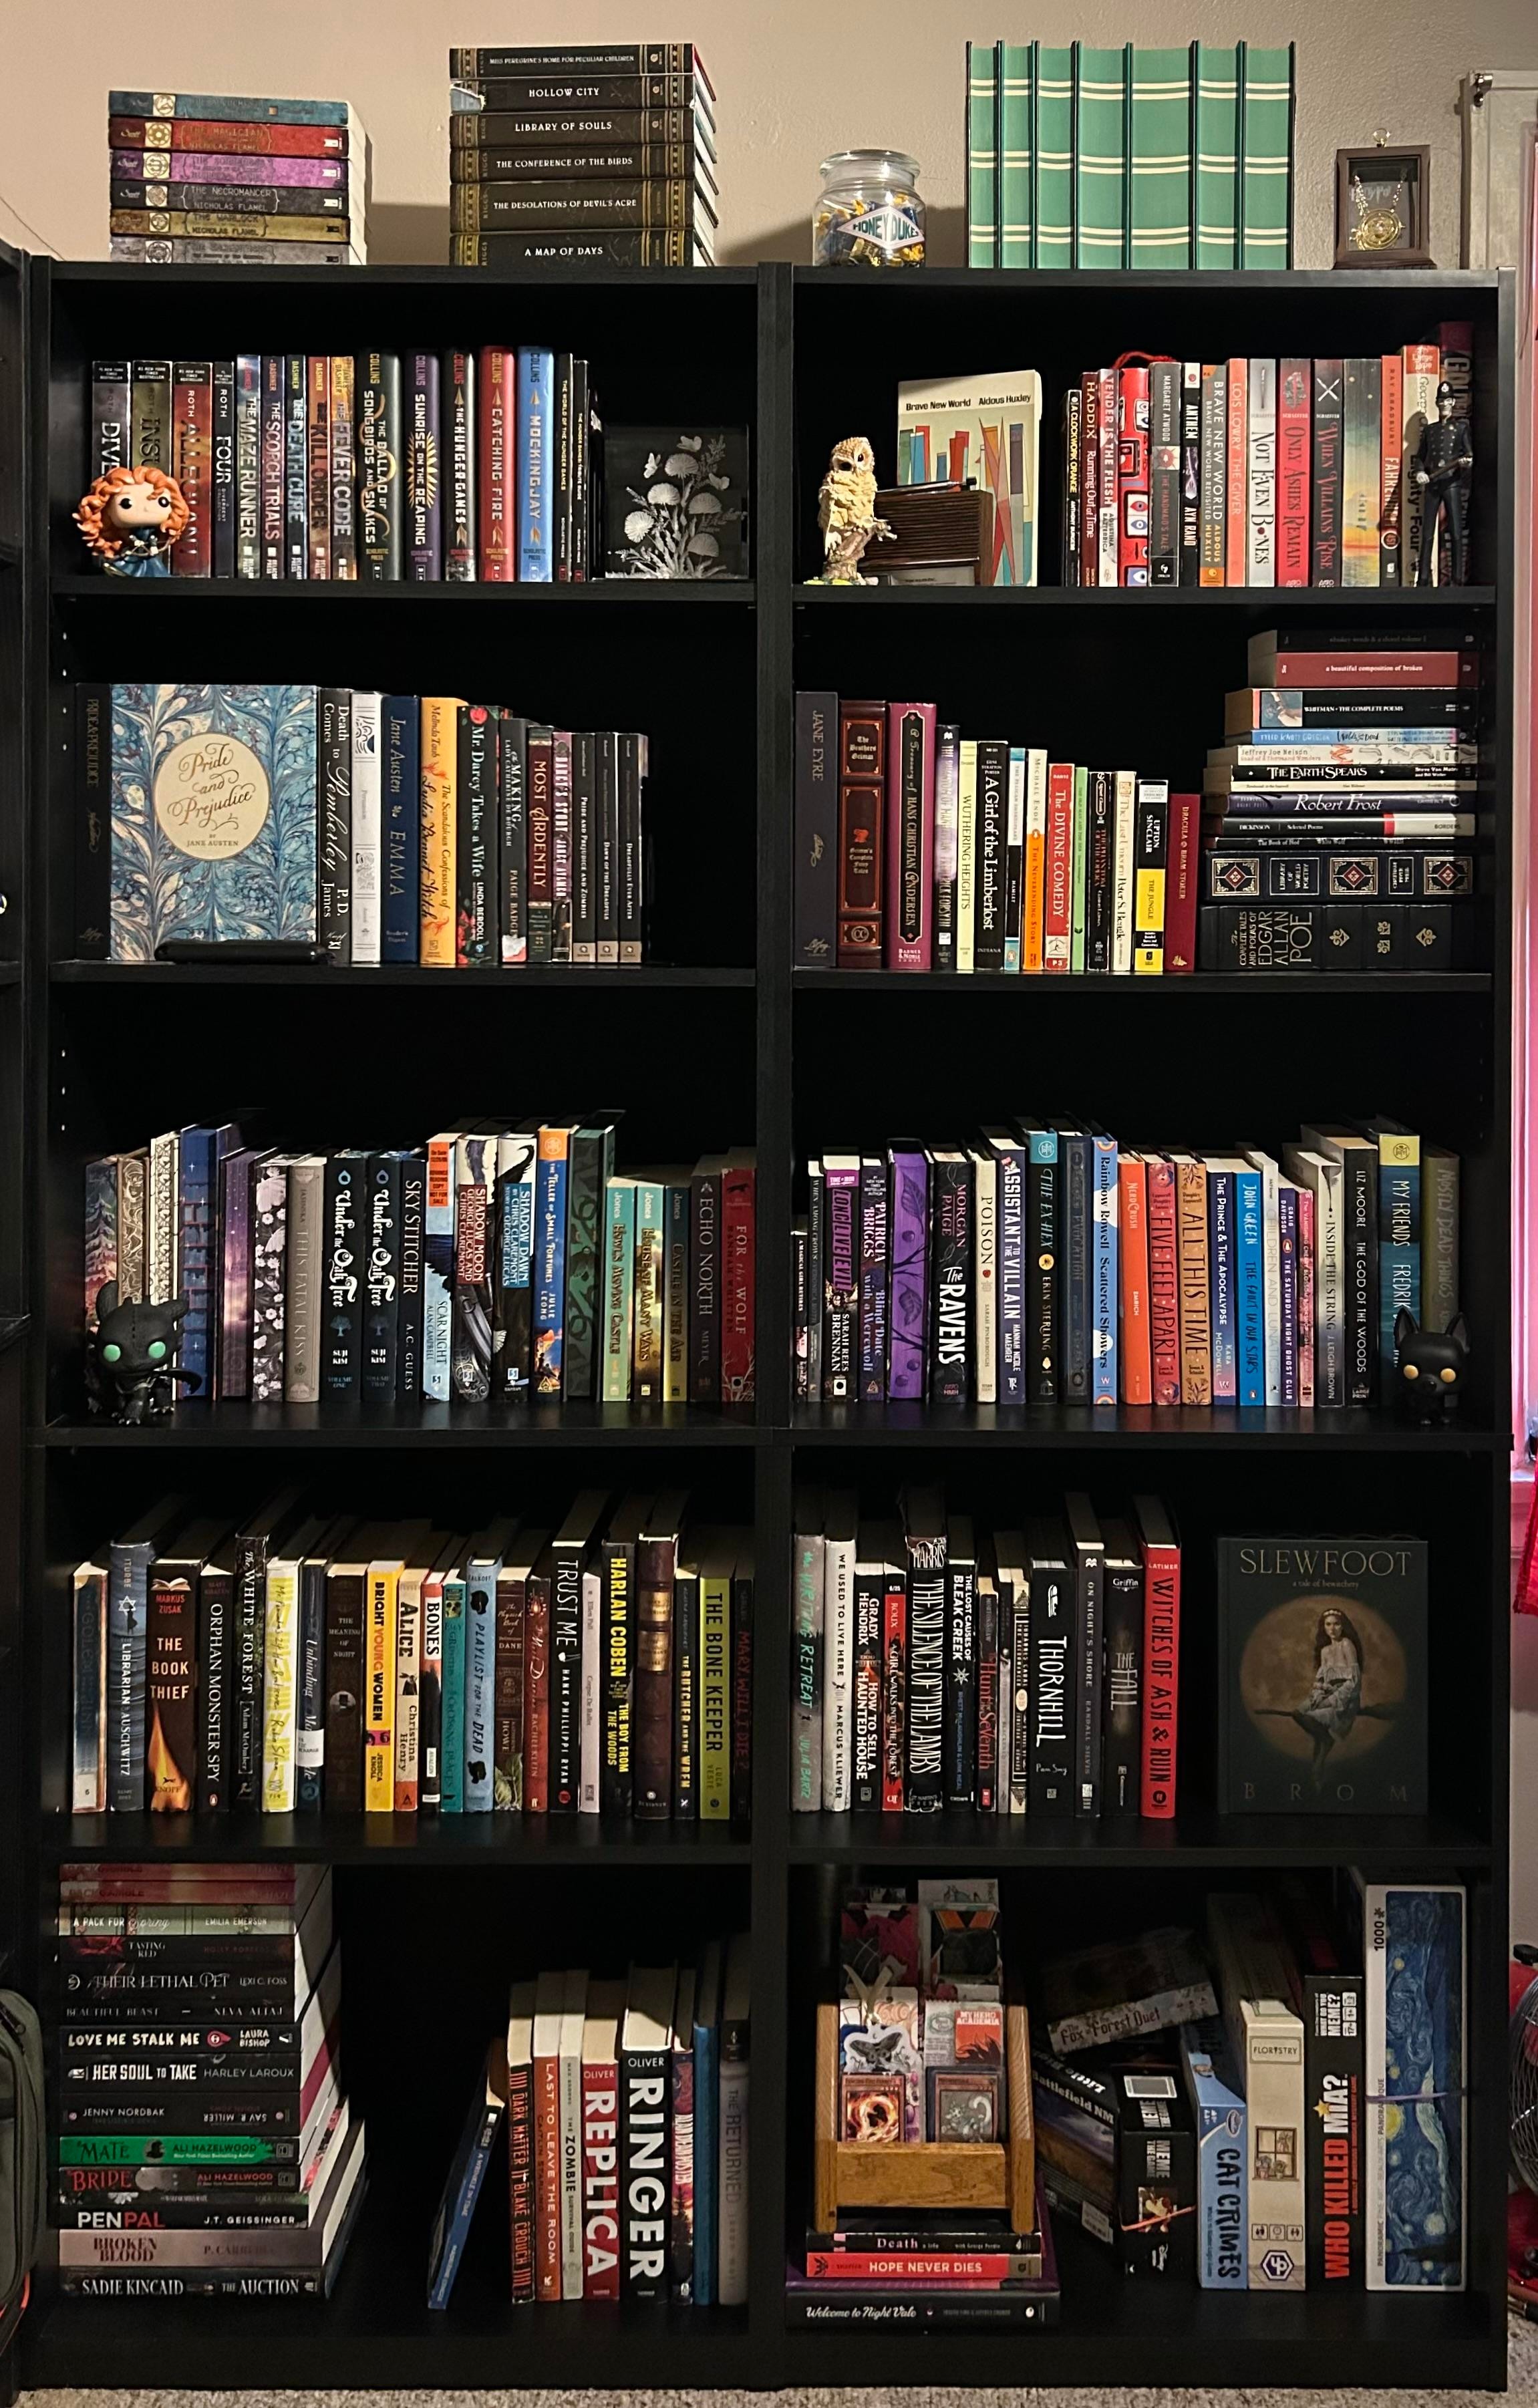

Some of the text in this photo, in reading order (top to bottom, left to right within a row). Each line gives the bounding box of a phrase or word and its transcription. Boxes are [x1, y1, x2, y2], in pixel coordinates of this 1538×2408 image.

[529, 88, 600, 98] HOLLOW CITY
[515, 121, 612, 132] LIBRARY OF SOULS
[496, 156, 633, 168] THE CONFERENCE OF THE BIRDS
[524, 248, 532, 256] A
[534, 248, 556, 256] MAP
[577, 247, 603, 255] DAYS
[906, 394, 1031, 411] Brave New World Aldous Huxley
[1086, 381, 1097, 438] HADDIX
[215, 436, 231, 484] FOUR
[491, 408, 502, 520] CATCHING FIRE
[529, 352, 541, 519] COLLINS MOCKINGJAY
[239, 396, 257, 539] THE MAZE RUNNER
[415, 394, 426, 545] SUNRISE ON THE REAPING
[178, 742, 234, 782] Pride
[471, 726, 484, 748] Mr.
[812, 710, 824, 781] JANE EYRE
[468, 751, 484, 790] Darcy
[167, 783, 257, 831] Prejudice
[320, 762, 350, 871] Pemberley
[471, 794, 484, 832] Takes
[1294, 792, 1381, 812] Robert Frost
[390, 830, 405, 896] EMMA
[471, 845, 484, 877] Wife
[960, 794, 972, 909] WUTHERING HEIGHTS
[983, 776, 999, 929] A Girl of the Limberlost
[1052, 790, 1066, 918] The DIVINE COMEDY
[1145, 814, 1154, 853] SINCLAIR
[1258, 911, 1272, 966] EDGAR
[1274, 911, 1289, 966] ALLAN
[1289, 912, 1312, 963] POE
[402, 1180, 422, 1294] SKY STITCHER
[696, 1198, 714, 1316] ECHO NORTH
[980, 1196, 993, 1264] POISON
[1004, 1167, 1021, 1320] ASSISTANT TO THE VILLAIN
[1099, 1157, 1110, 1368] Rainbow Rowell Scattered Showers
[1356, 1170, 1367, 1373] LIZ MOORE THE GOD OF THE WOODS
[937, 1266, 966, 1364] The RAVENS
[404, 1353, 414, 1391] GUESS
[1239, 1548, 1412, 1577] SLEWFOOT
[157, 1637, 182, 1650] THE
[426, 1602, 440, 1656] BONES
[610, 1557, 627, 1677] HARLAN COBEN
[859, 1593, 869, 1646] HENDRIX
[868, 1598, 880, 1640] GRADY
[152, 1661, 189, 1675] BOOK
[372, 1582, 385, 1721] BRIGHT YOUNG WOMEN
[706, 1593, 723, 1752] THE BONE KEEPER
[834, 1554, 846, 1799] WE USED TO LIVE HERE MARCUS KLIEWER
[909, 1578, 945, 1775] THE SILENCE OF THE LAMBS
[1149, 1577, 1174, 1783] WITCHES OF ASH & RUIN
[150, 1685, 189, 1699] THIEF
[207, 1603, 224, 1782] ORPHAN MONSTER SPY
[1036, 1636, 1068, 1747] THORNHILL
[856, 1672, 869, 1781] HAUNTED HOUSE
[68, 2033, 200, 2047] LOVE ME STALK ME
[92, 2064, 197, 2081] HER SOUL TO TAKE
[546, 2063, 557, 2264] LAST TO LEAVE THE ROOM
[585, 2090, 618, 2276] REPLICA
[628, 2077, 665, 2280] RINGER
[1323, 2073, 1349, 2279] WHO KILLED MIA?
[1217, 2147, 1241, 2280] CAT CRIMES
[82, 2279, 300, 2295] SADIE KINCAID AUCTION
[869, 2262, 983, 2273] HOPE NEVER DIES
[806, 2306, 917, 2320] Welcome to Night Vale
